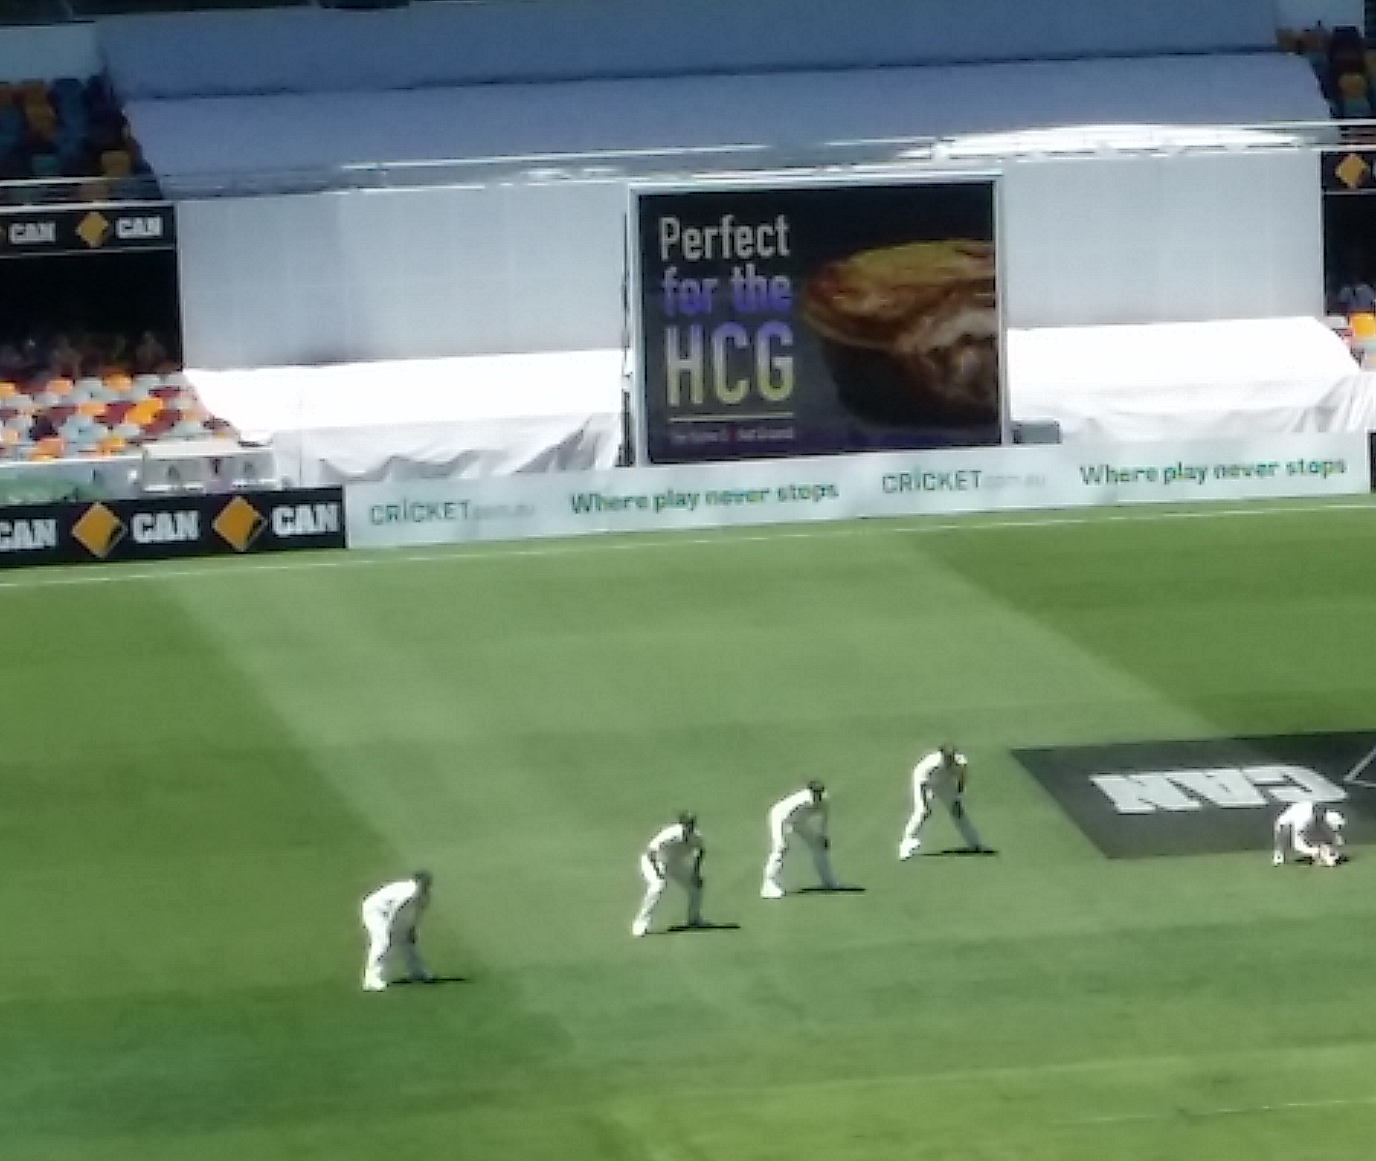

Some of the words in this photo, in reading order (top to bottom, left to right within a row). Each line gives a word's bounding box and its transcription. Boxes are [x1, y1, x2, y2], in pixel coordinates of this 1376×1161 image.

[9, 221, 56, 244] CAN
[116, 215, 163, 239] CAN
[658, 213, 790, 261] Perfect
[662, 265, 718, 315] for
[730, 263, 793, 314] the
[665, 320, 794, 407] HCG
[1079, 463, 1158, 486] Where
[1164, 460, 1207, 486] play
[1213, 460, 1280, 480] never
[1285, 457, 1347, 480] stops
[571, 492, 648, 515] Where
[655, 488, 700, 514] play
[706, 488, 770, 506] never
[777, 482, 839, 503] stops
[131, 511, 199, 543] CAN
[271, 504, 338, 536] CAN
[1090, 765, 1346, 814] CAN
